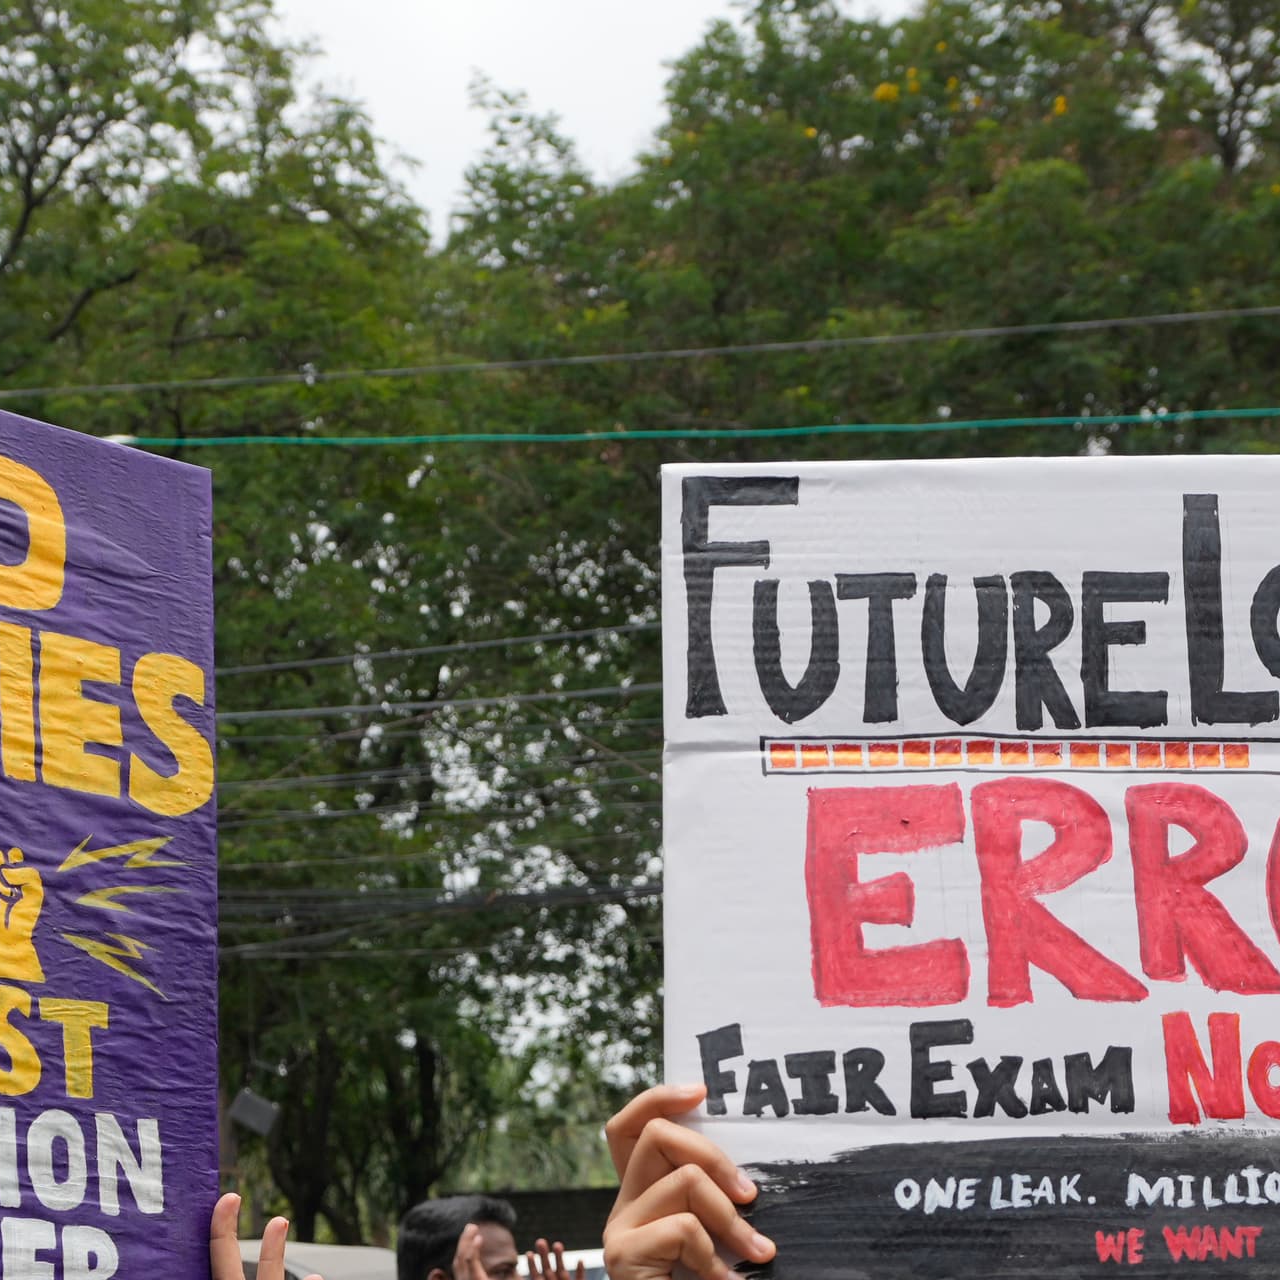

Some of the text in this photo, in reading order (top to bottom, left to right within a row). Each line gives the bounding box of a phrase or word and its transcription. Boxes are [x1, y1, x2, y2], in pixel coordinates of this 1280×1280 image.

[894, 1177, 981, 1215] ONE
[990, 1172, 1097, 1210] LEAK.
[1095, 1226, 1146, 1265] WE
[1162, 1224, 1263, 1263] WANT
